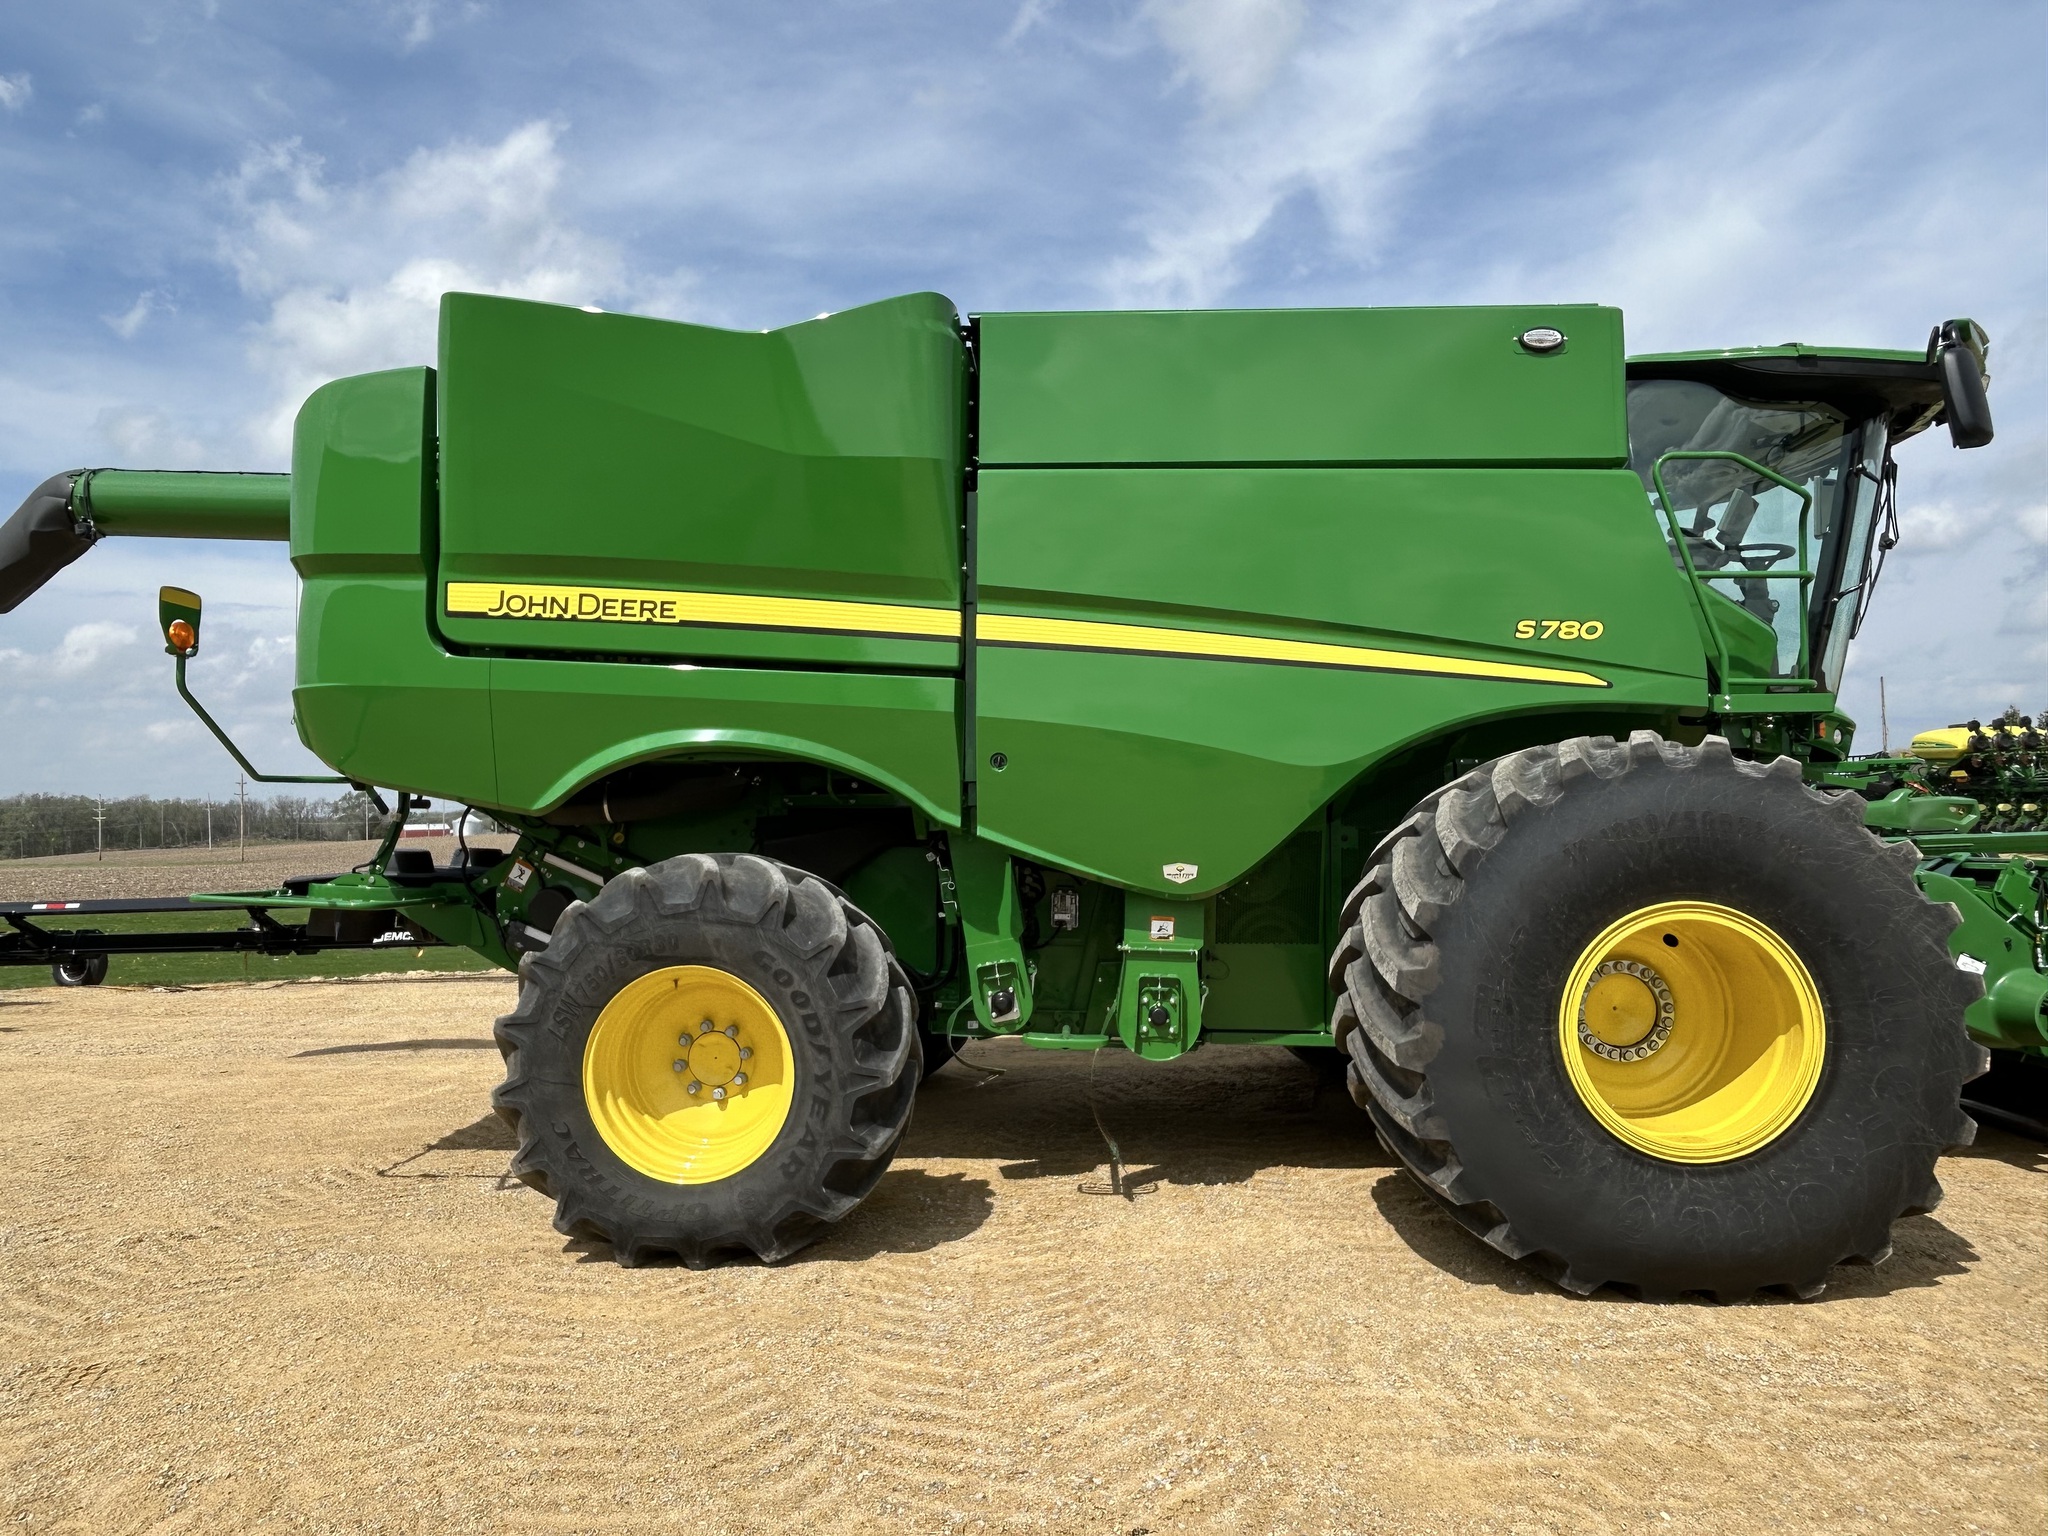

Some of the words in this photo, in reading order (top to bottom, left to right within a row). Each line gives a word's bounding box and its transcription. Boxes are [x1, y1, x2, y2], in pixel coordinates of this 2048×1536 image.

[488, 590, 569, 615] JOHN
[577, 593, 678, 619] DEERE
[752, 950, 834, 1181] GOODYEAR
[551, 1121, 710, 1223] OPTITRAC
